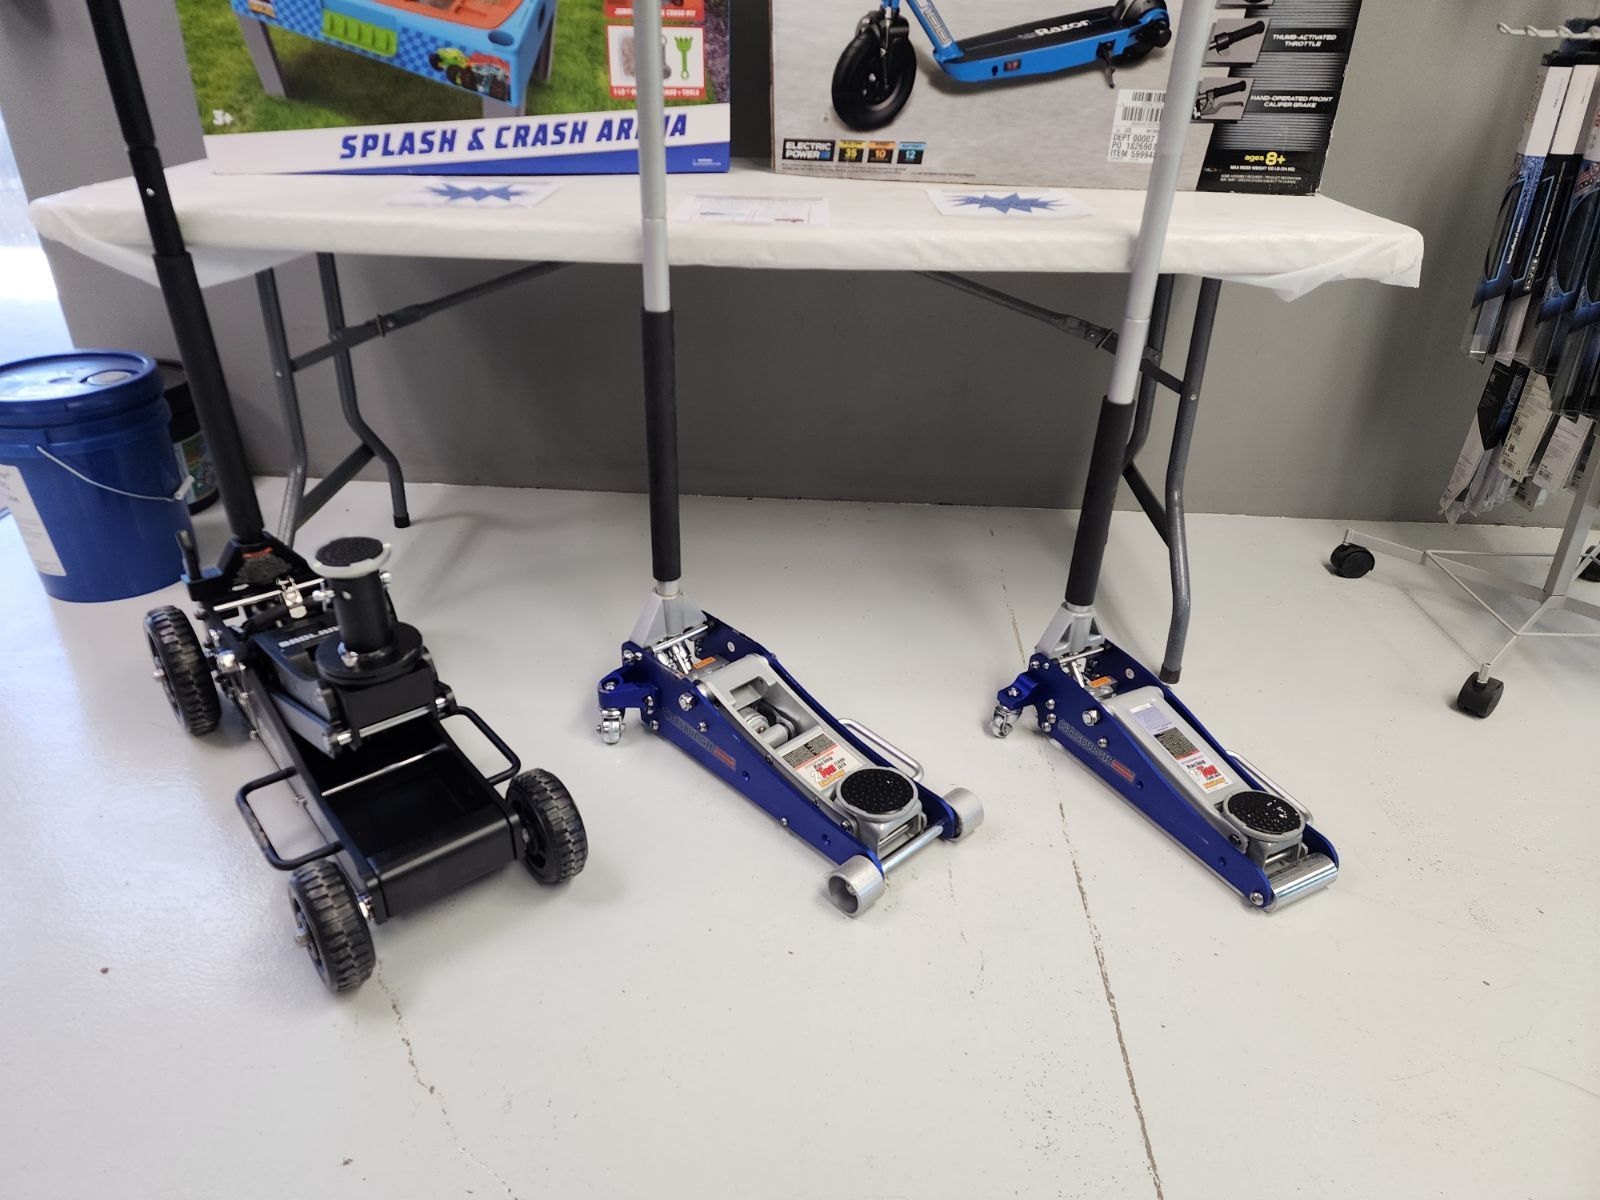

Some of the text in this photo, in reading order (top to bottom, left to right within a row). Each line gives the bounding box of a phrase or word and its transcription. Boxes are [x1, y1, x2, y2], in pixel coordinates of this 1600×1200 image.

[1034, 20, 1089, 36] Razor
[212, 109, 234, 126] 3+
[339, 114, 687, 159] SPLASH & CRASH ARA
[1112, 133, 1156, 143] DEPT 00007
[785, 141, 832, 151] ELECTRIC
[1111, 141, 1156, 151] PO 182690
[785, 149, 821, 159] POWER
[875, 149, 887, 159] 10
[905, 150, 917, 160] 12
[1110, 150, 1154, 159] ITEM 59994
[1244, 151, 1286, 166] ages 8+
[813, 756, 833, 769] Racing
[1186, 760, 1206, 769] Racing
